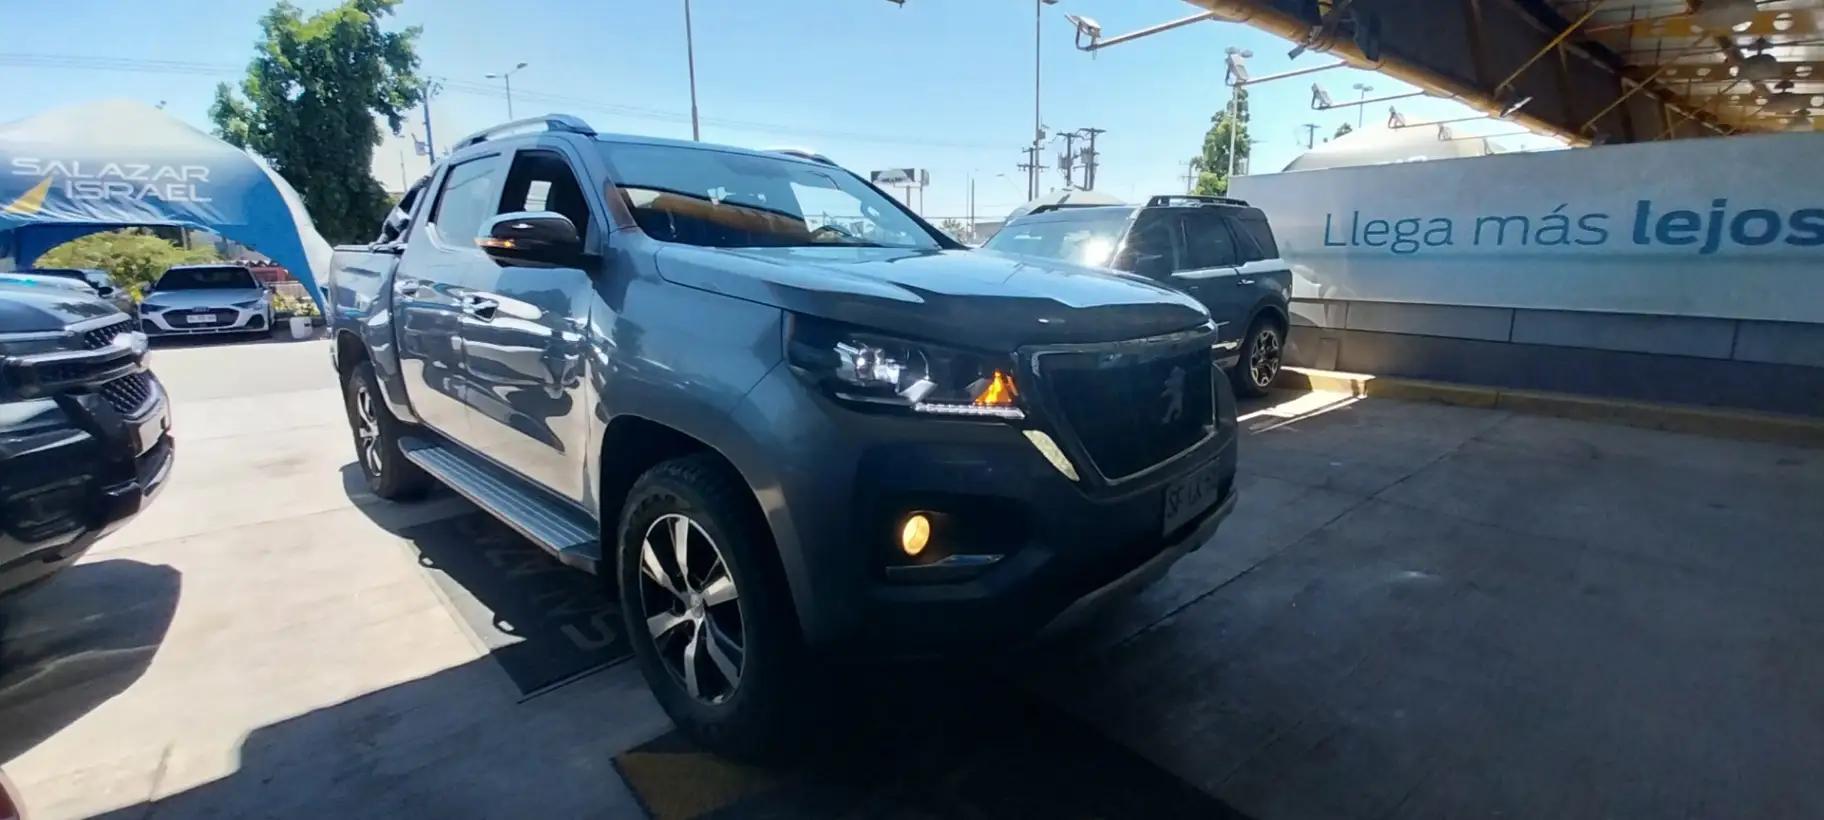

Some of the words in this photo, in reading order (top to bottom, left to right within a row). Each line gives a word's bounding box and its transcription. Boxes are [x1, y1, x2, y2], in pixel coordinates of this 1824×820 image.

[11, 157, 210, 182] SALAZAR
[65, 180, 212, 202] ISRAEL
[1324, 210, 1453, 254] Llega
[1473, 203, 1610, 246] más
[1632, 198, 1824, 255] lejos
